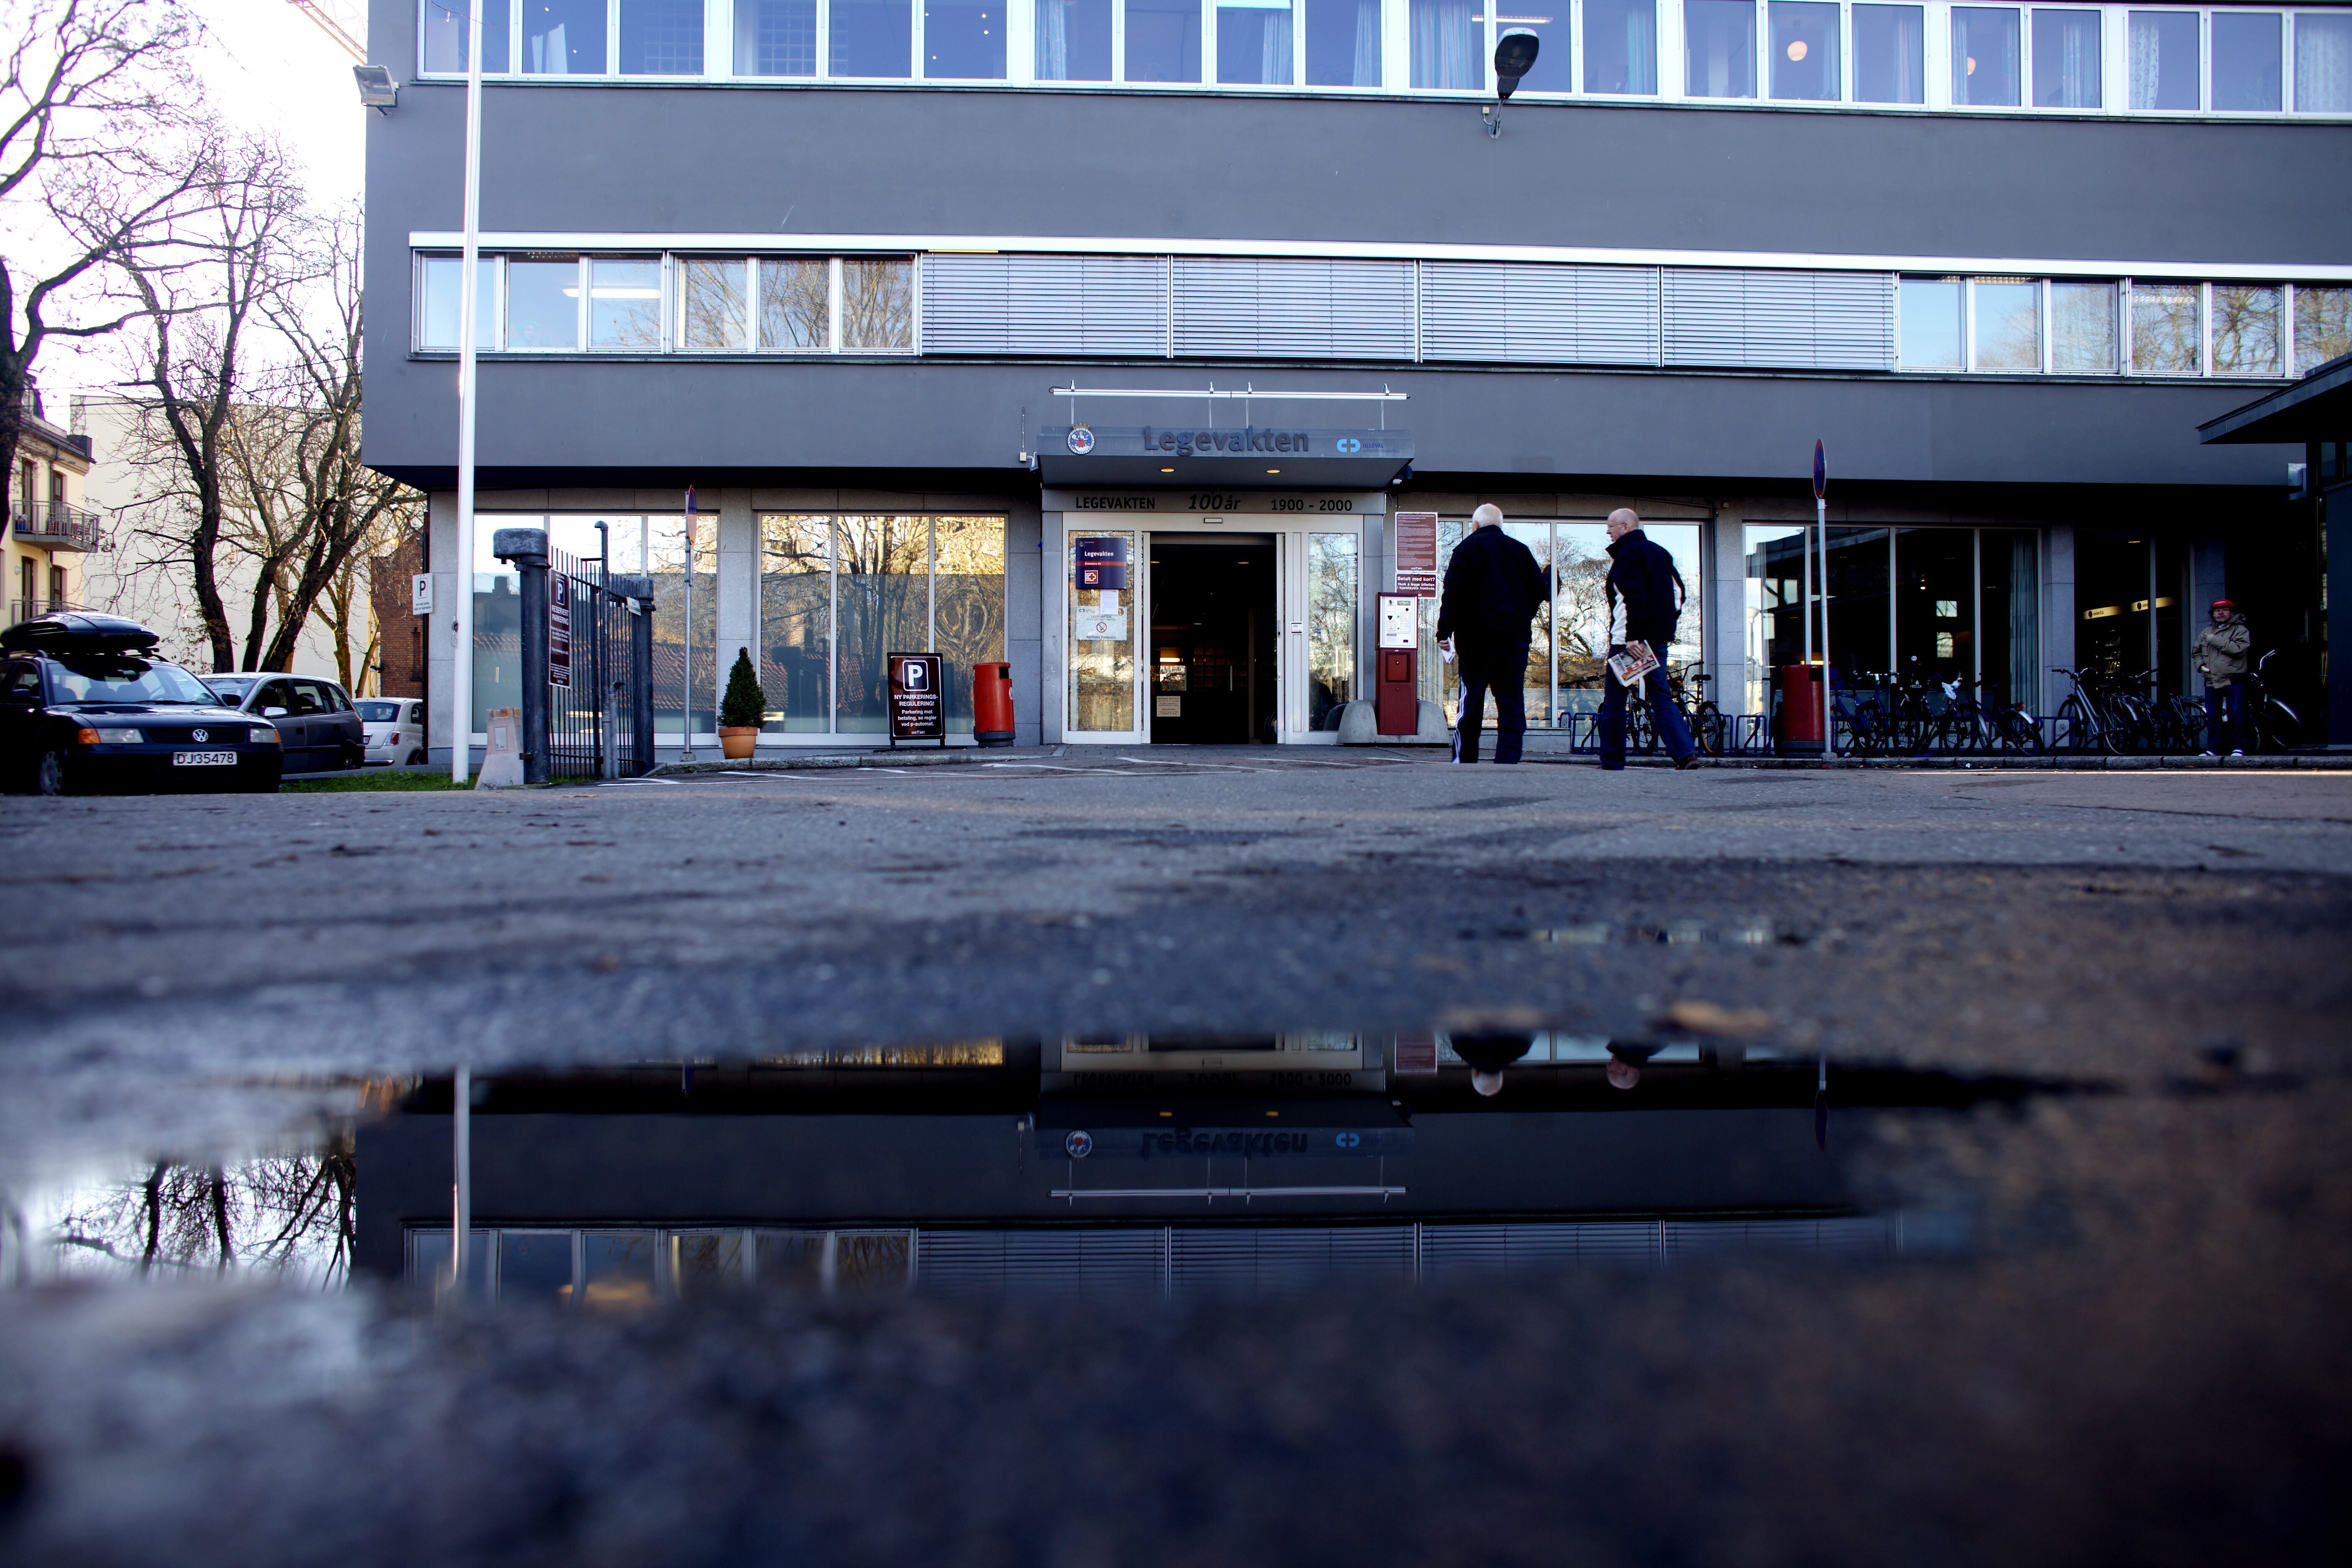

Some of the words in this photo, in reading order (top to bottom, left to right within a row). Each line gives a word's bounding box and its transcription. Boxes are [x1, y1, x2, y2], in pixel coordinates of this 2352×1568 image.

[1145, 426, 1308, 456] Legevakten
[1075, 497, 1155, 509] LEGEVAKTEN
[1188, 494, 1222, 510] 100
[1224, 495, 1241, 510] år
[1271, 499, 1304, 511] 1900
[1319, 499, 1352, 511] 2000
[420, 580, 426, 596] P
[557, 582, 563, 600] P
[908, 665, 923, 686] P
